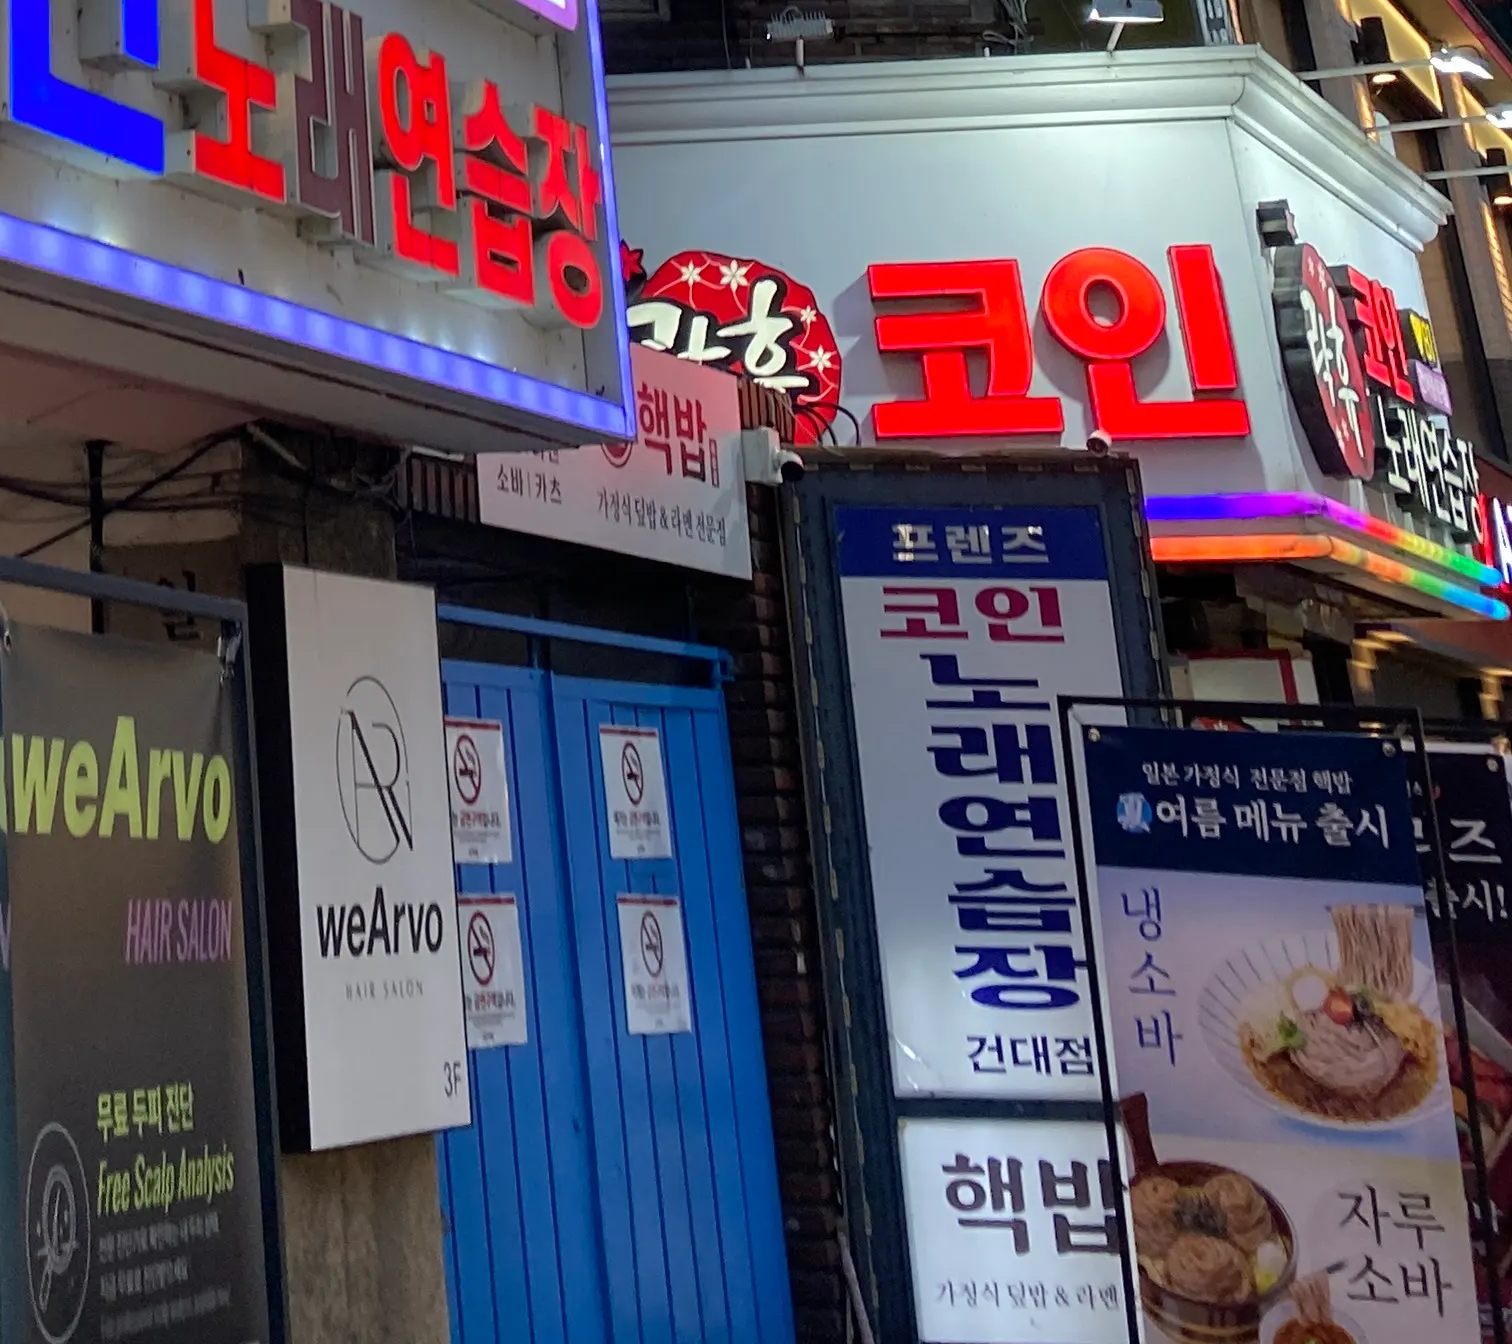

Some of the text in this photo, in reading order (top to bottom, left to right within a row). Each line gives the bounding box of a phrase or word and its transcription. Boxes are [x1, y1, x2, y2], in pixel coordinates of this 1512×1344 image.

[867, 244, 1252, 440] 코인
[1347, 264, 1416, 405] 코인
[637, 381, 707, 483] 핵밥
[496, 463, 524, 498] 소바
[1375, 393, 1485, 545] 노래연습장
[597, 487, 632, 526] 가정식
[695, 512, 727, 547] 전문점
[892, 522, 1049, 565] 프렌즈
[880, 584, 1066, 645] 코인
[11, 714, 232, 845] weArvo
[1141, 760, 1179, 787] 일본
[1184, 762, 1240, 791] 가정식
[1250, 765, 1308, 793] 전문점
[919, 653, 1089, 1010] 노래연습장
[1155, 792, 1389, 850] 여름 메뉴 출시
[125, 898, 233, 966] HAIR SALON
[316, 884, 444, 959] weArvo
[345, 979, 425, 1002] HAIR SALON
[1121, 886, 1183, 1068] 냉소바
[443, 1061, 462, 1099] 3F
[966, 1034, 1095, 1076] 건대점
[97, 1138, 235, 1218] Free Scalp Analysis
[941, 1151, 1122, 1256] 핵밥
[1336, 1183, 1446, 1249] 자루
[936, 1278, 1001, 1310] 가정식
[1342, 1255, 1453, 1318] 소바
